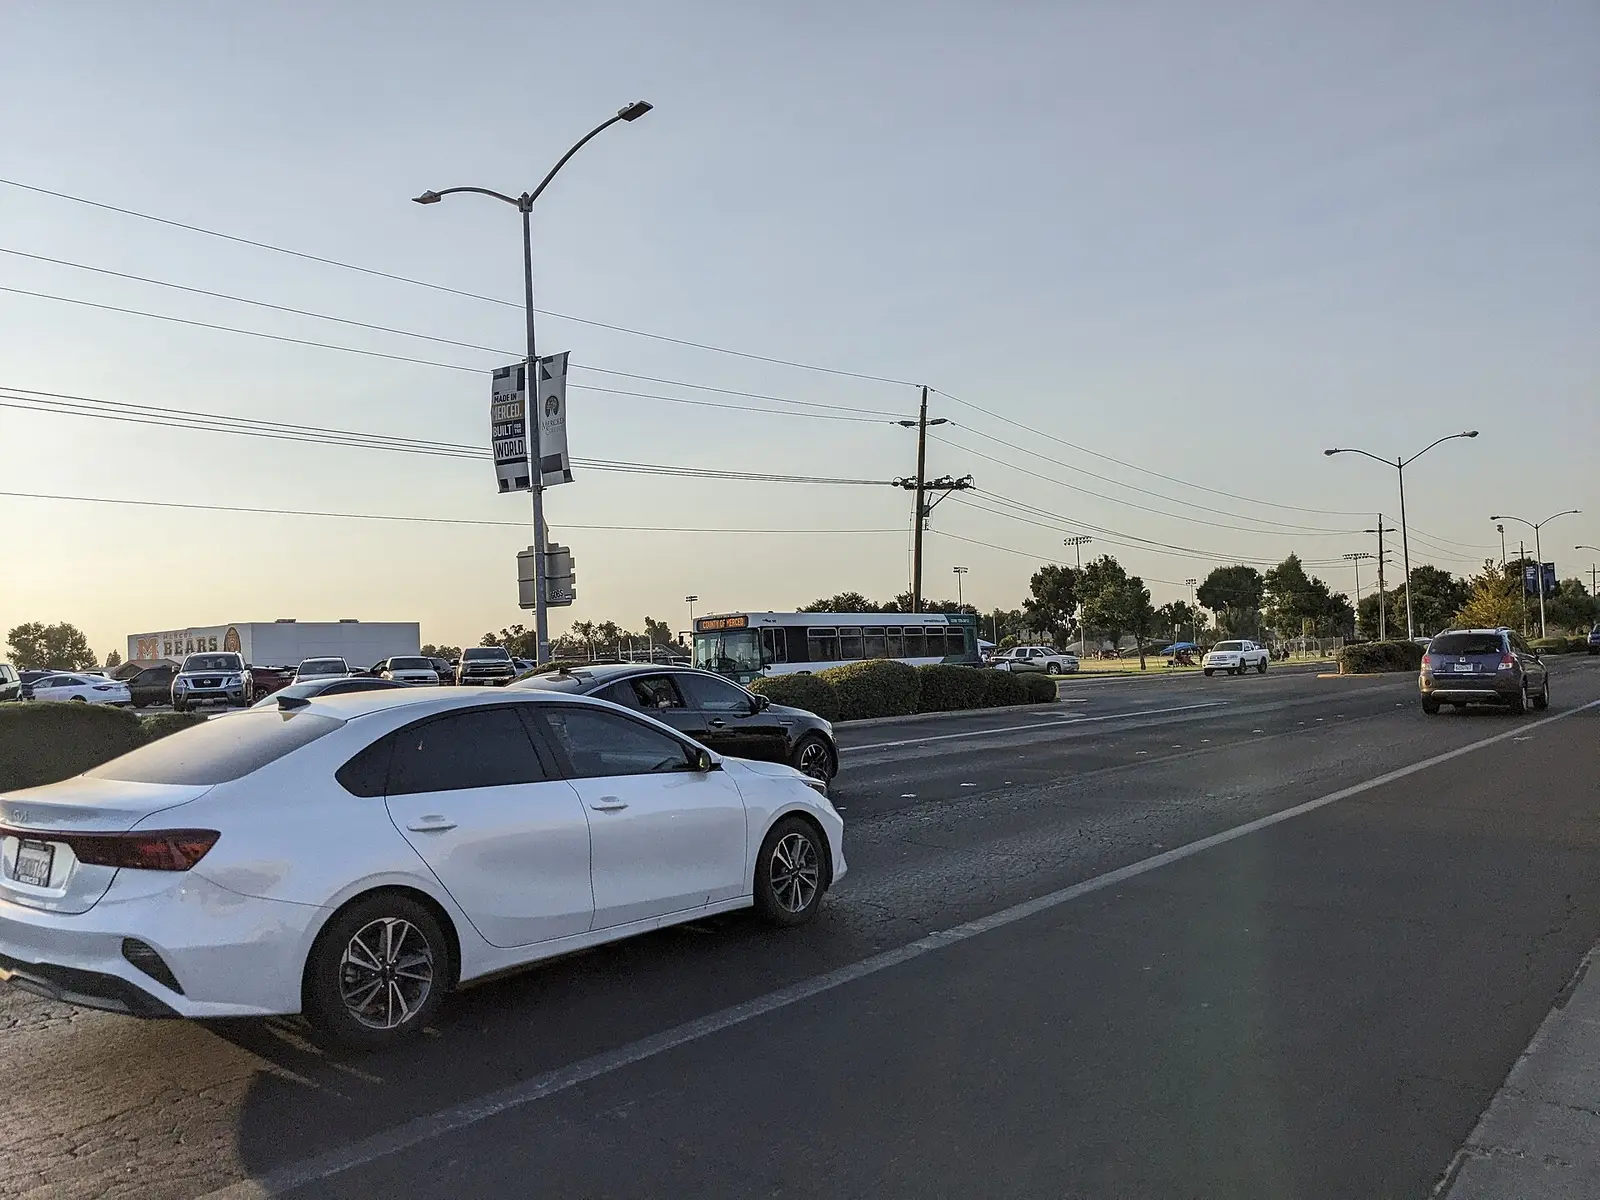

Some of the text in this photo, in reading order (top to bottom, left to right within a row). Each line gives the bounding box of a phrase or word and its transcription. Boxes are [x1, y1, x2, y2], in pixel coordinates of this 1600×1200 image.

[494, 394, 510, 403] MADE
[493, 424, 512, 437] BUILT
[495, 439, 527, 458] WORLD.
[703, 618, 744, 629] COUNTY OF MERCED
[137, 637, 159, 660] M
[163, 636, 218, 656] BEARS
